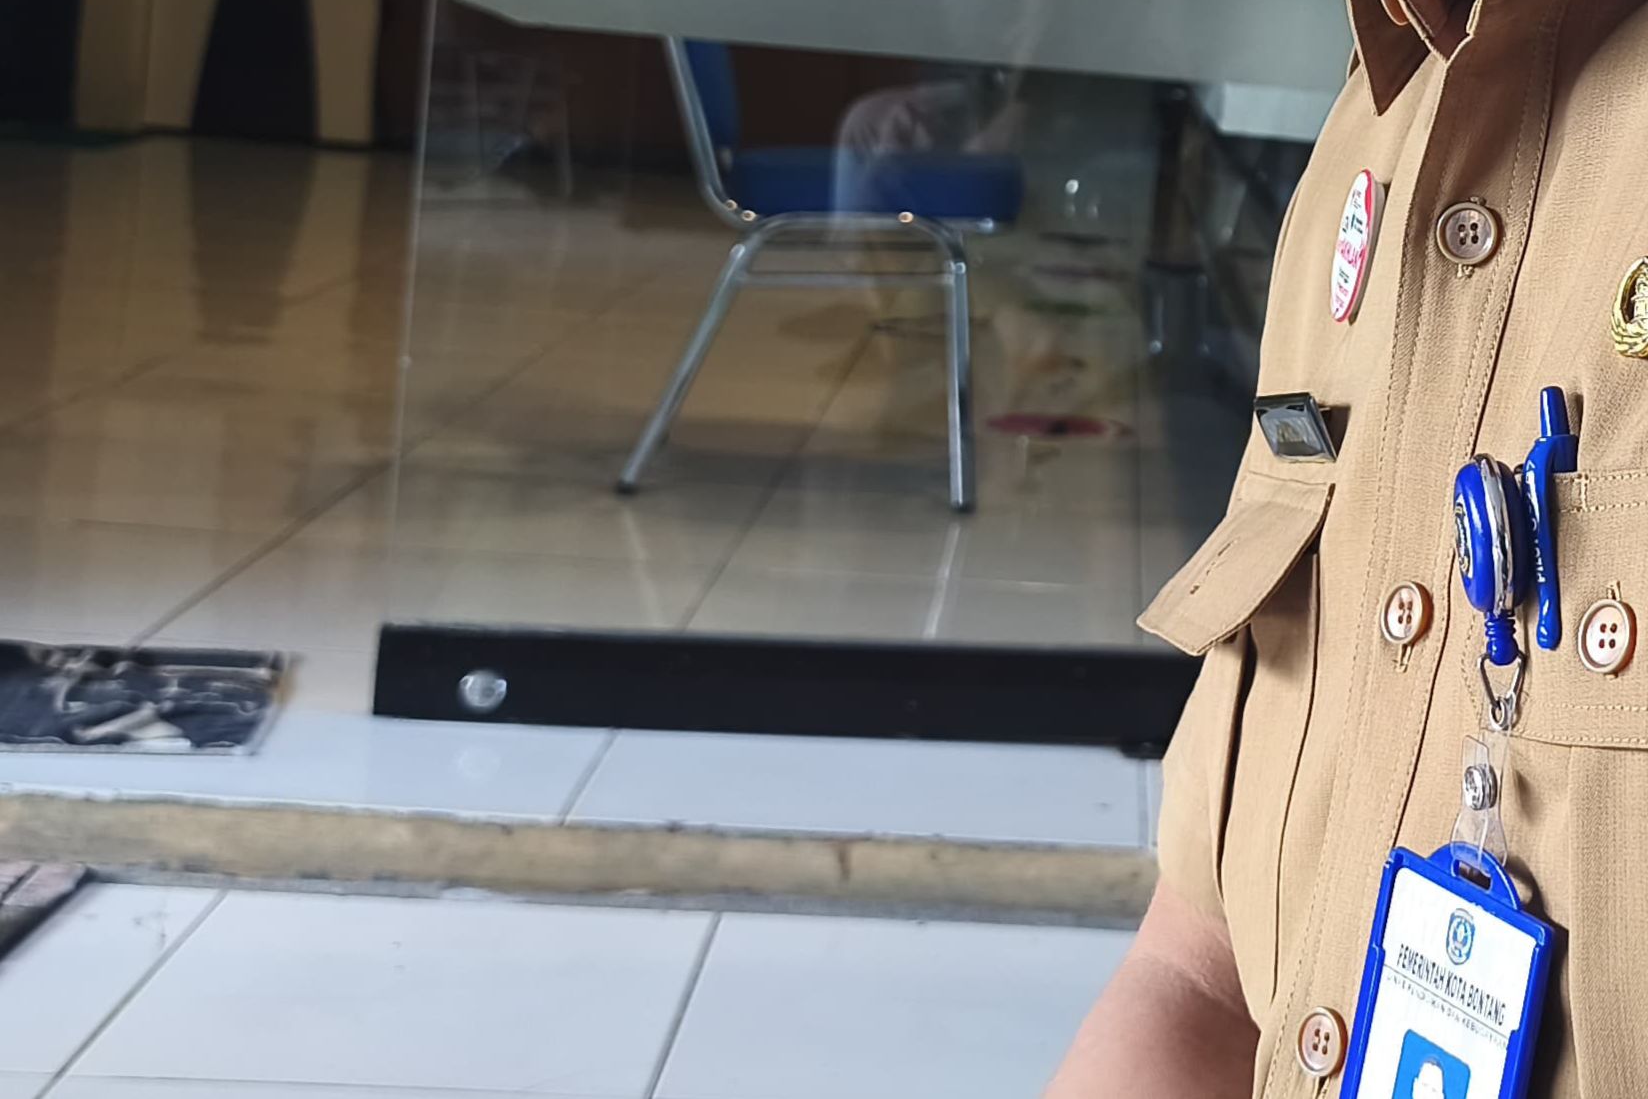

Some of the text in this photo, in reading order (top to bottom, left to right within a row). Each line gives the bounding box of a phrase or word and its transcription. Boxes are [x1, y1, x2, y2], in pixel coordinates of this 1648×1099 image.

[1396, 943, 1446, 991] PEMERINTAH
[1444, 970, 1468, 1006] KOTA
[1466, 984, 1506, 1026] BONTANG
